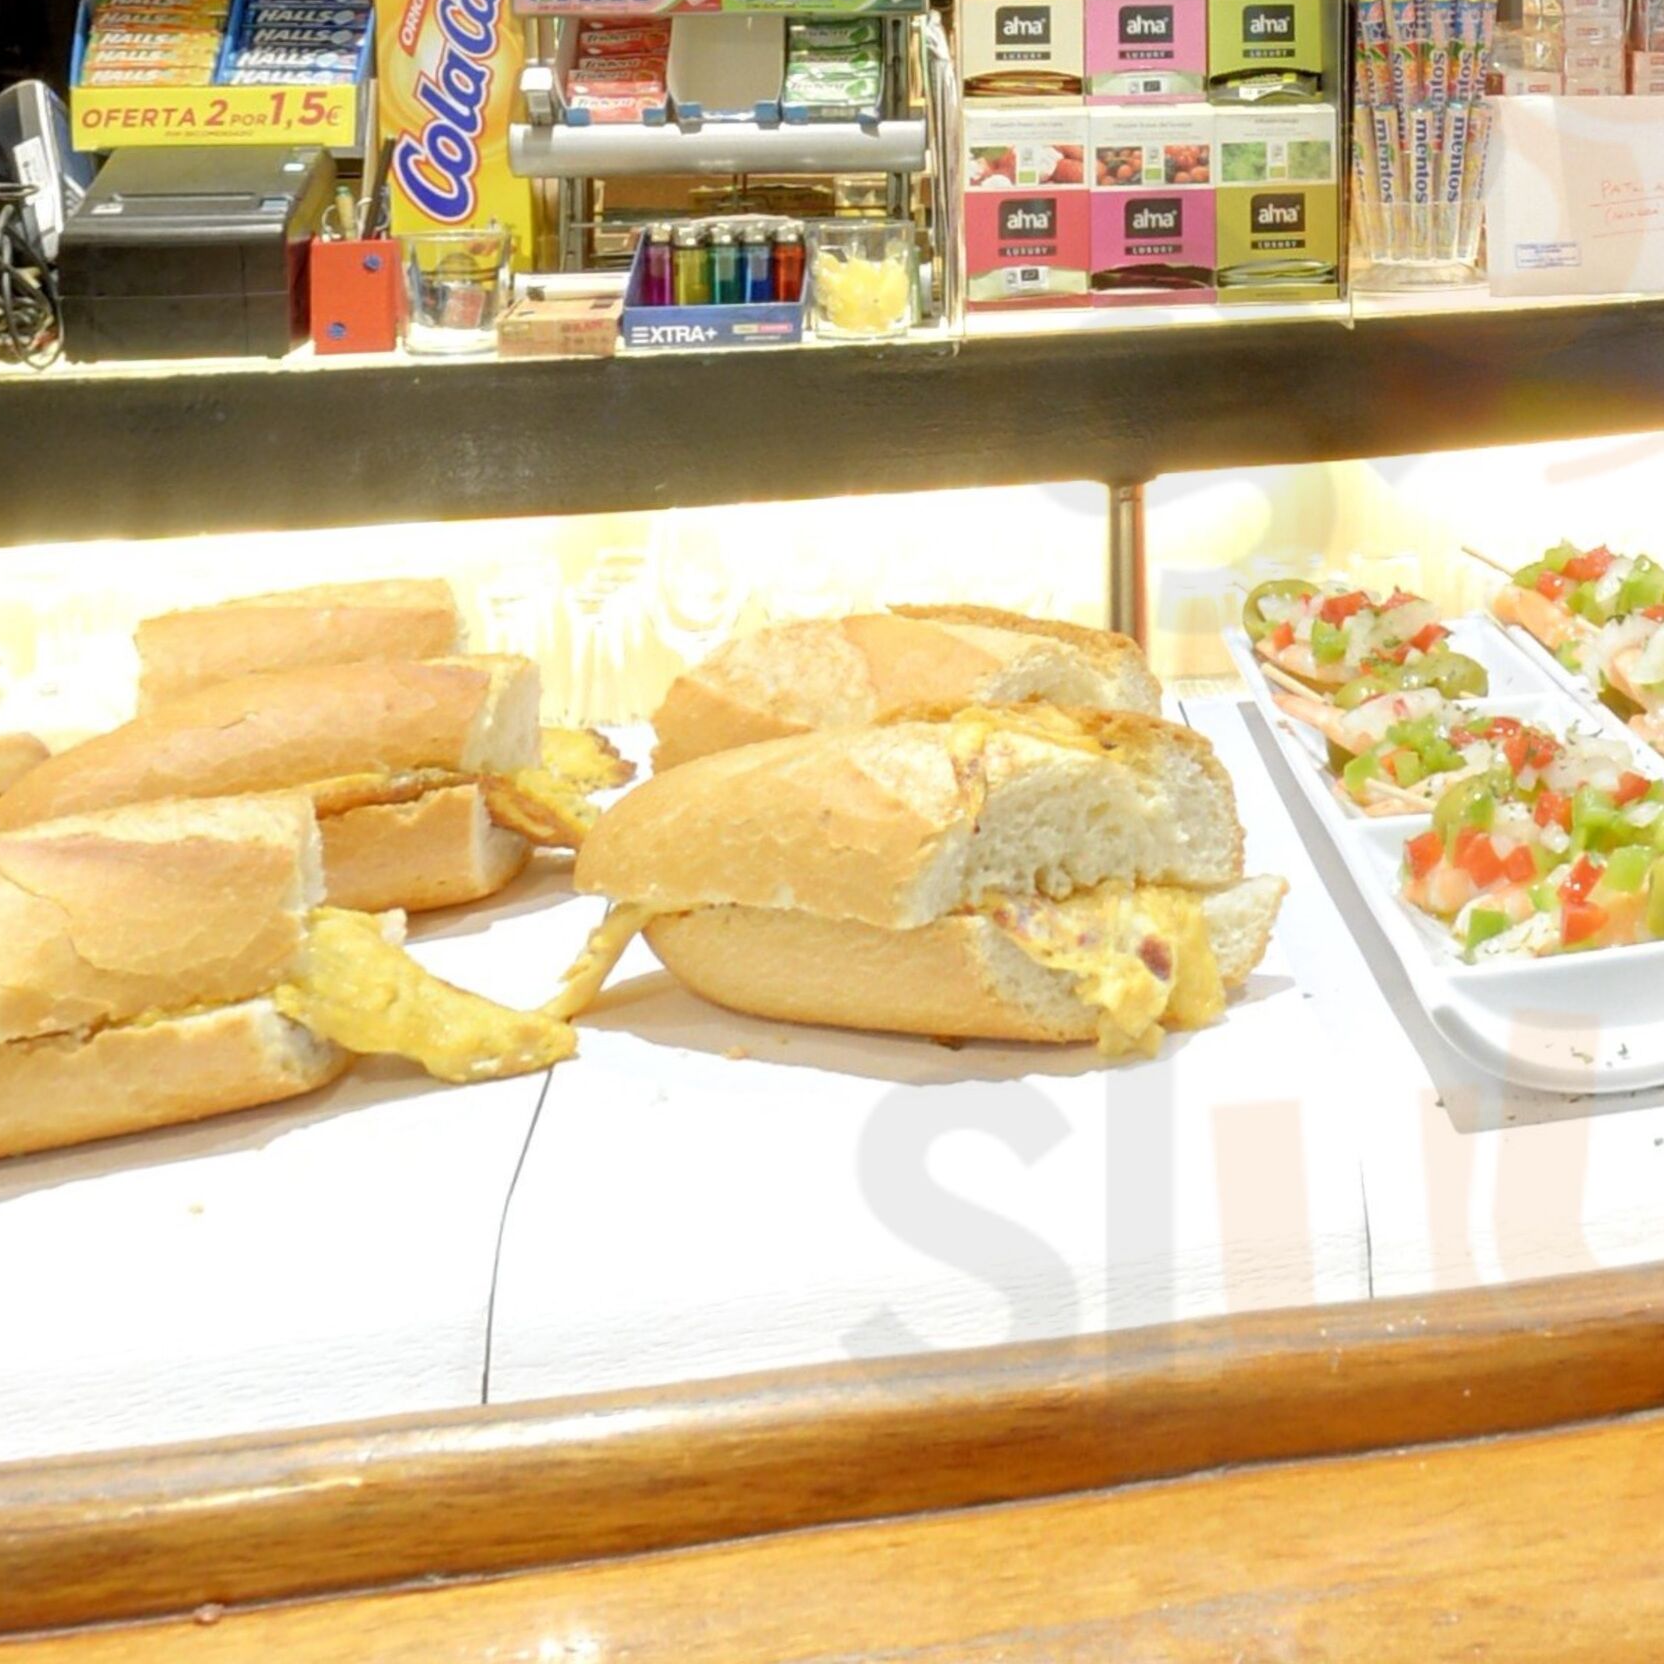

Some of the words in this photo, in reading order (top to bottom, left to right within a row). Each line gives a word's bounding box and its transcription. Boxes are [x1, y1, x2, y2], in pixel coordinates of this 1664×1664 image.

[257, 8, 334, 24] HALLS
[1003, 16, 1045, 35] alma
[1125, 15, 1168, 35] alma
[1249, 15, 1290, 34] alma
[100, 32, 166, 47] HALLS
[96, 49, 163, 65] HALLS
[237, 50, 321, 68] HALLS
[82, 106, 197, 129] OFERTA
[204, 99, 227, 127] 2
[231, 114, 268, 127] POR
[1375, 118, 1393, 205] mentos
[1416, 118, 1429, 205] mentos
[1447, 116, 1464, 204] mentos
[1006, 208, 1051, 229] alma
[1132, 208, 1176, 229] alma
[1257, 203, 1300, 224] alma
